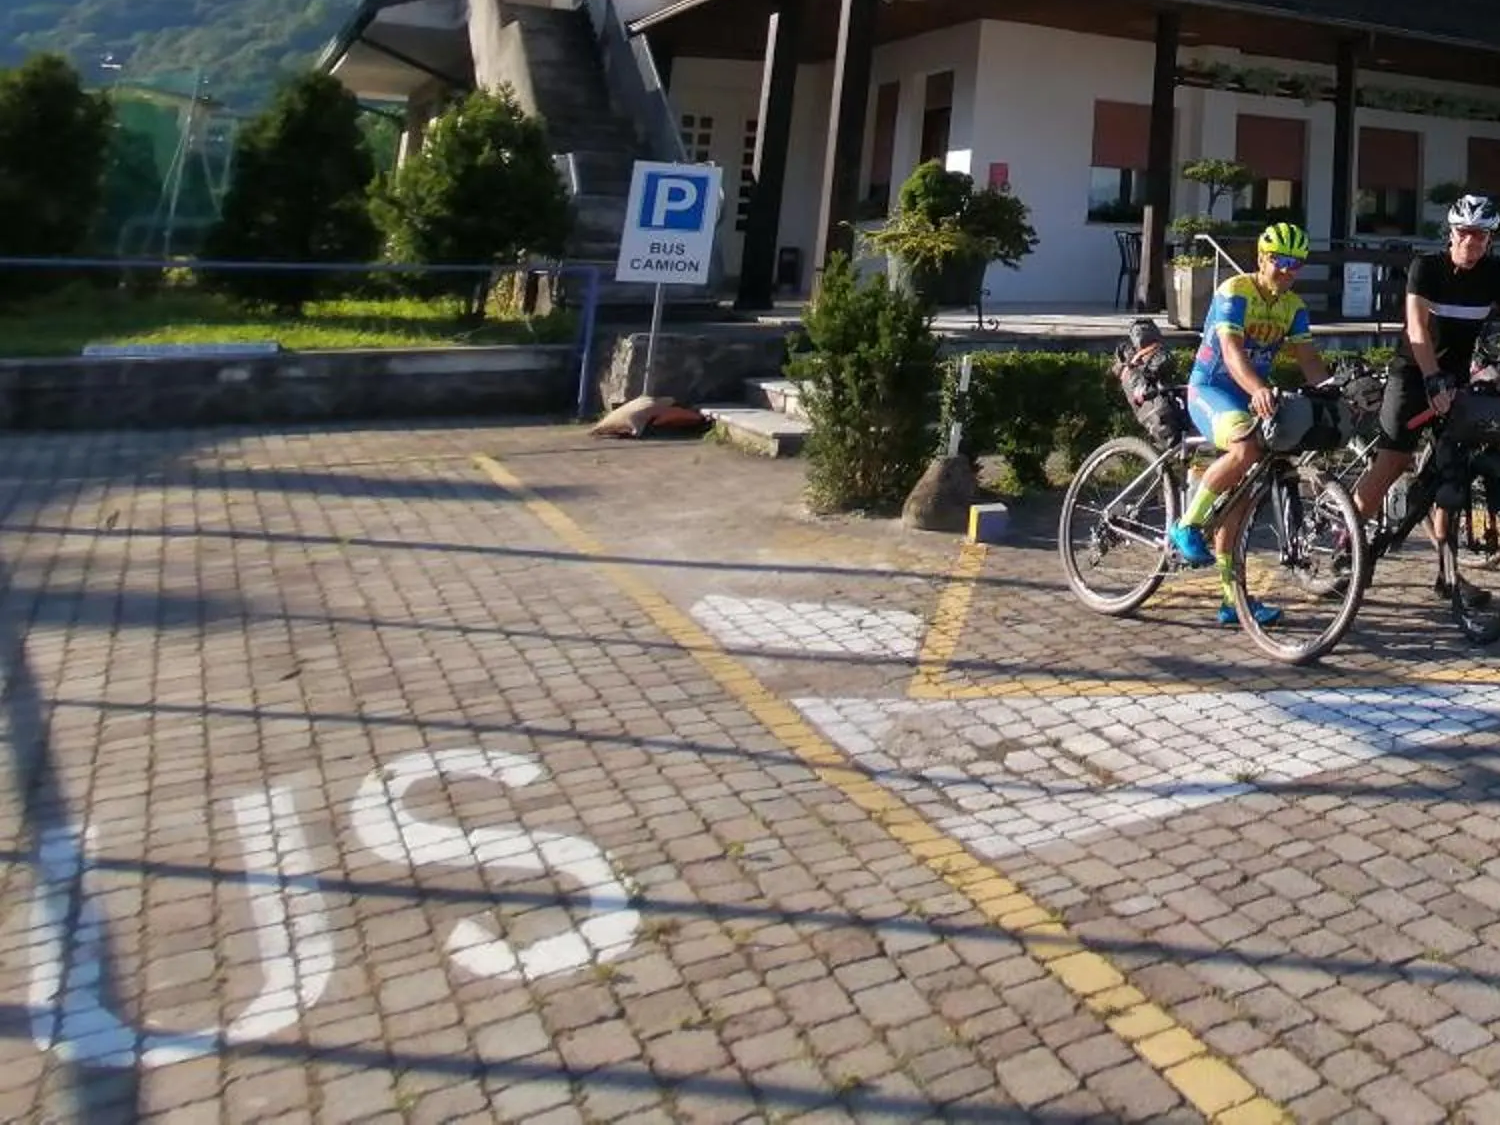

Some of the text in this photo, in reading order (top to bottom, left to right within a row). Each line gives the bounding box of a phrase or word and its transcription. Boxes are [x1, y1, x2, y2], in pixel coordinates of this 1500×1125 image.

[651, 178, 698, 226] P
[649, 242, 686, 256] BUS
[630, 258, 700, 273] CAMION
